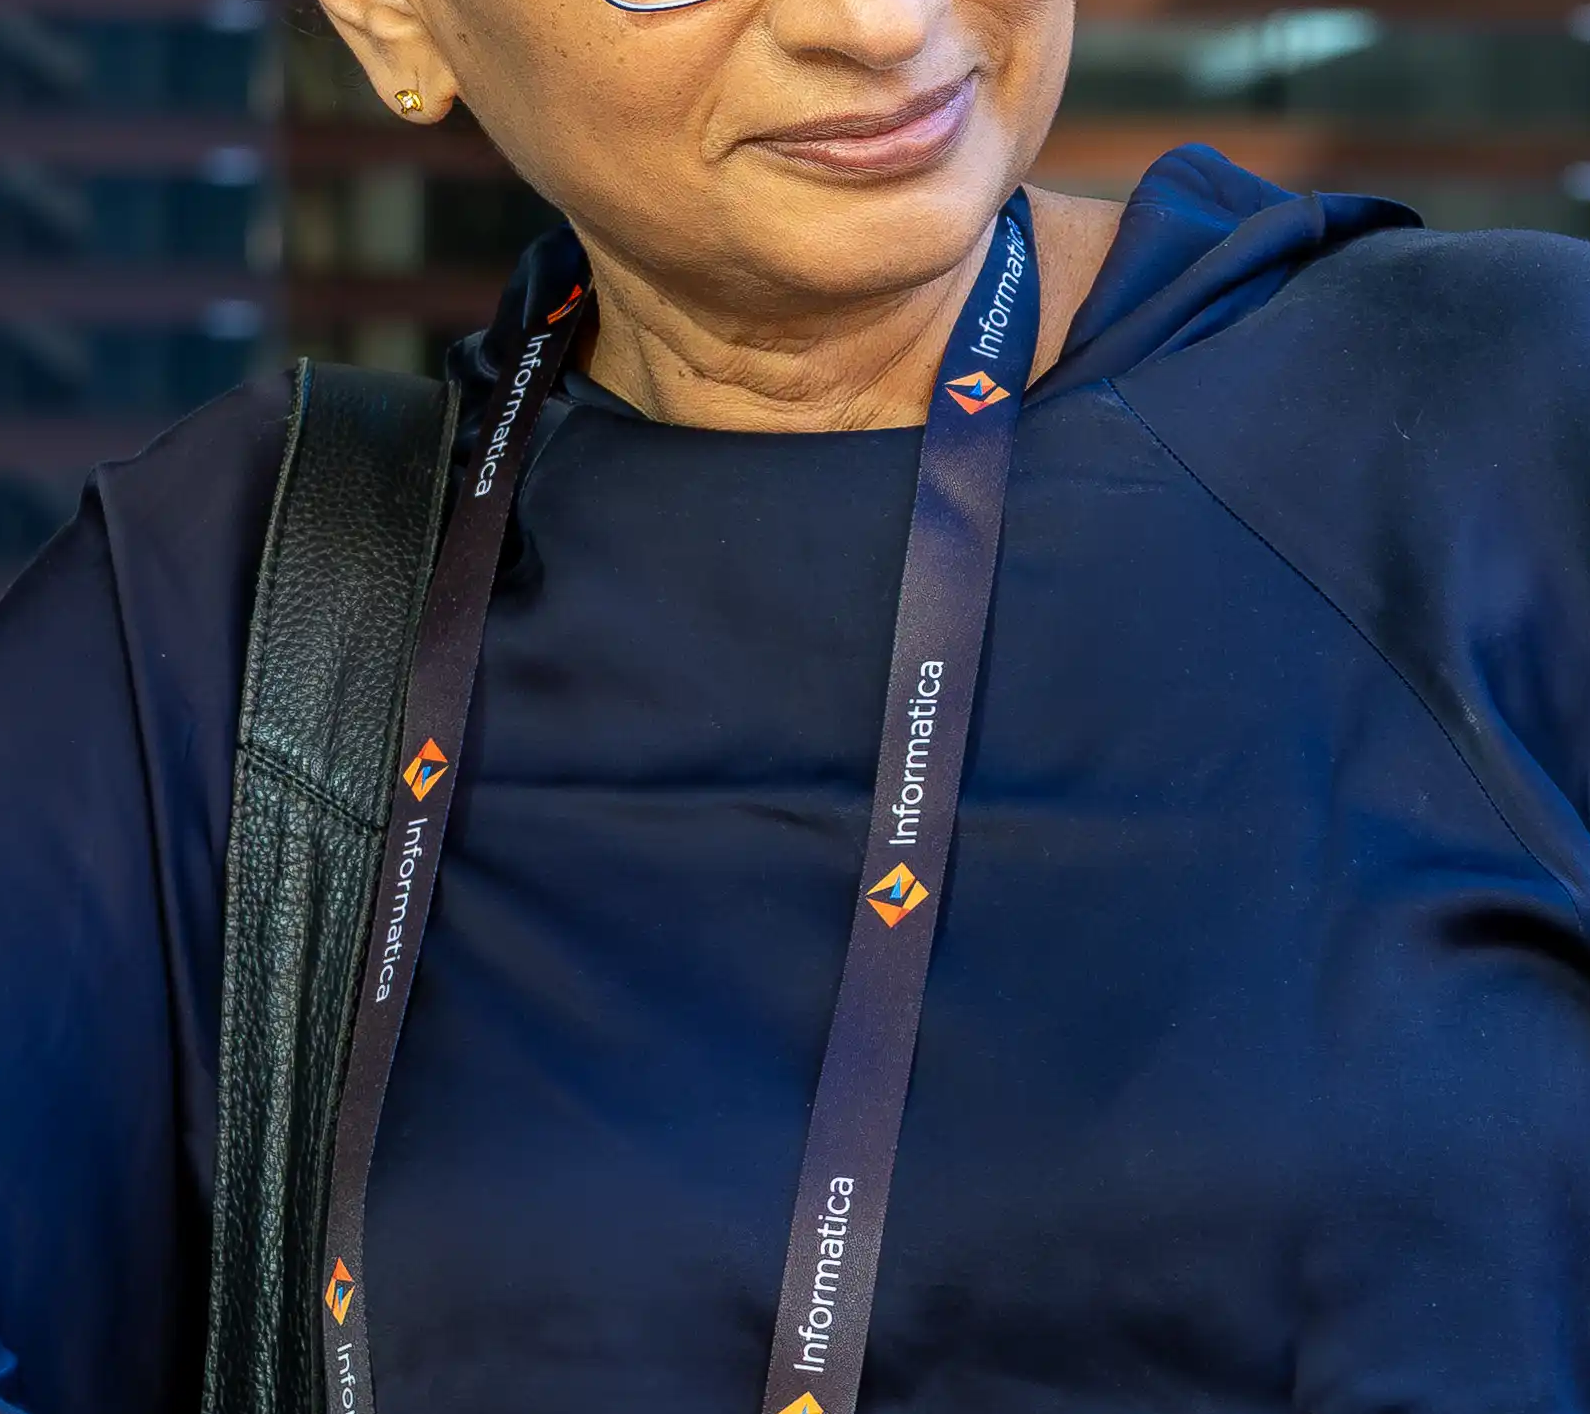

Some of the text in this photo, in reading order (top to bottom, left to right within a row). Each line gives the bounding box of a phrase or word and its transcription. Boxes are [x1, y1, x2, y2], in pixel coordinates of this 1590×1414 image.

[971, 216, 1026, 359] Informatica
[474, 333, 552, 498] Informatica
[889, 659, 945, 847] Informatica
[375, 817, 429, 1003] Informatica
[793, 1175, 855, 1374] Informatica
